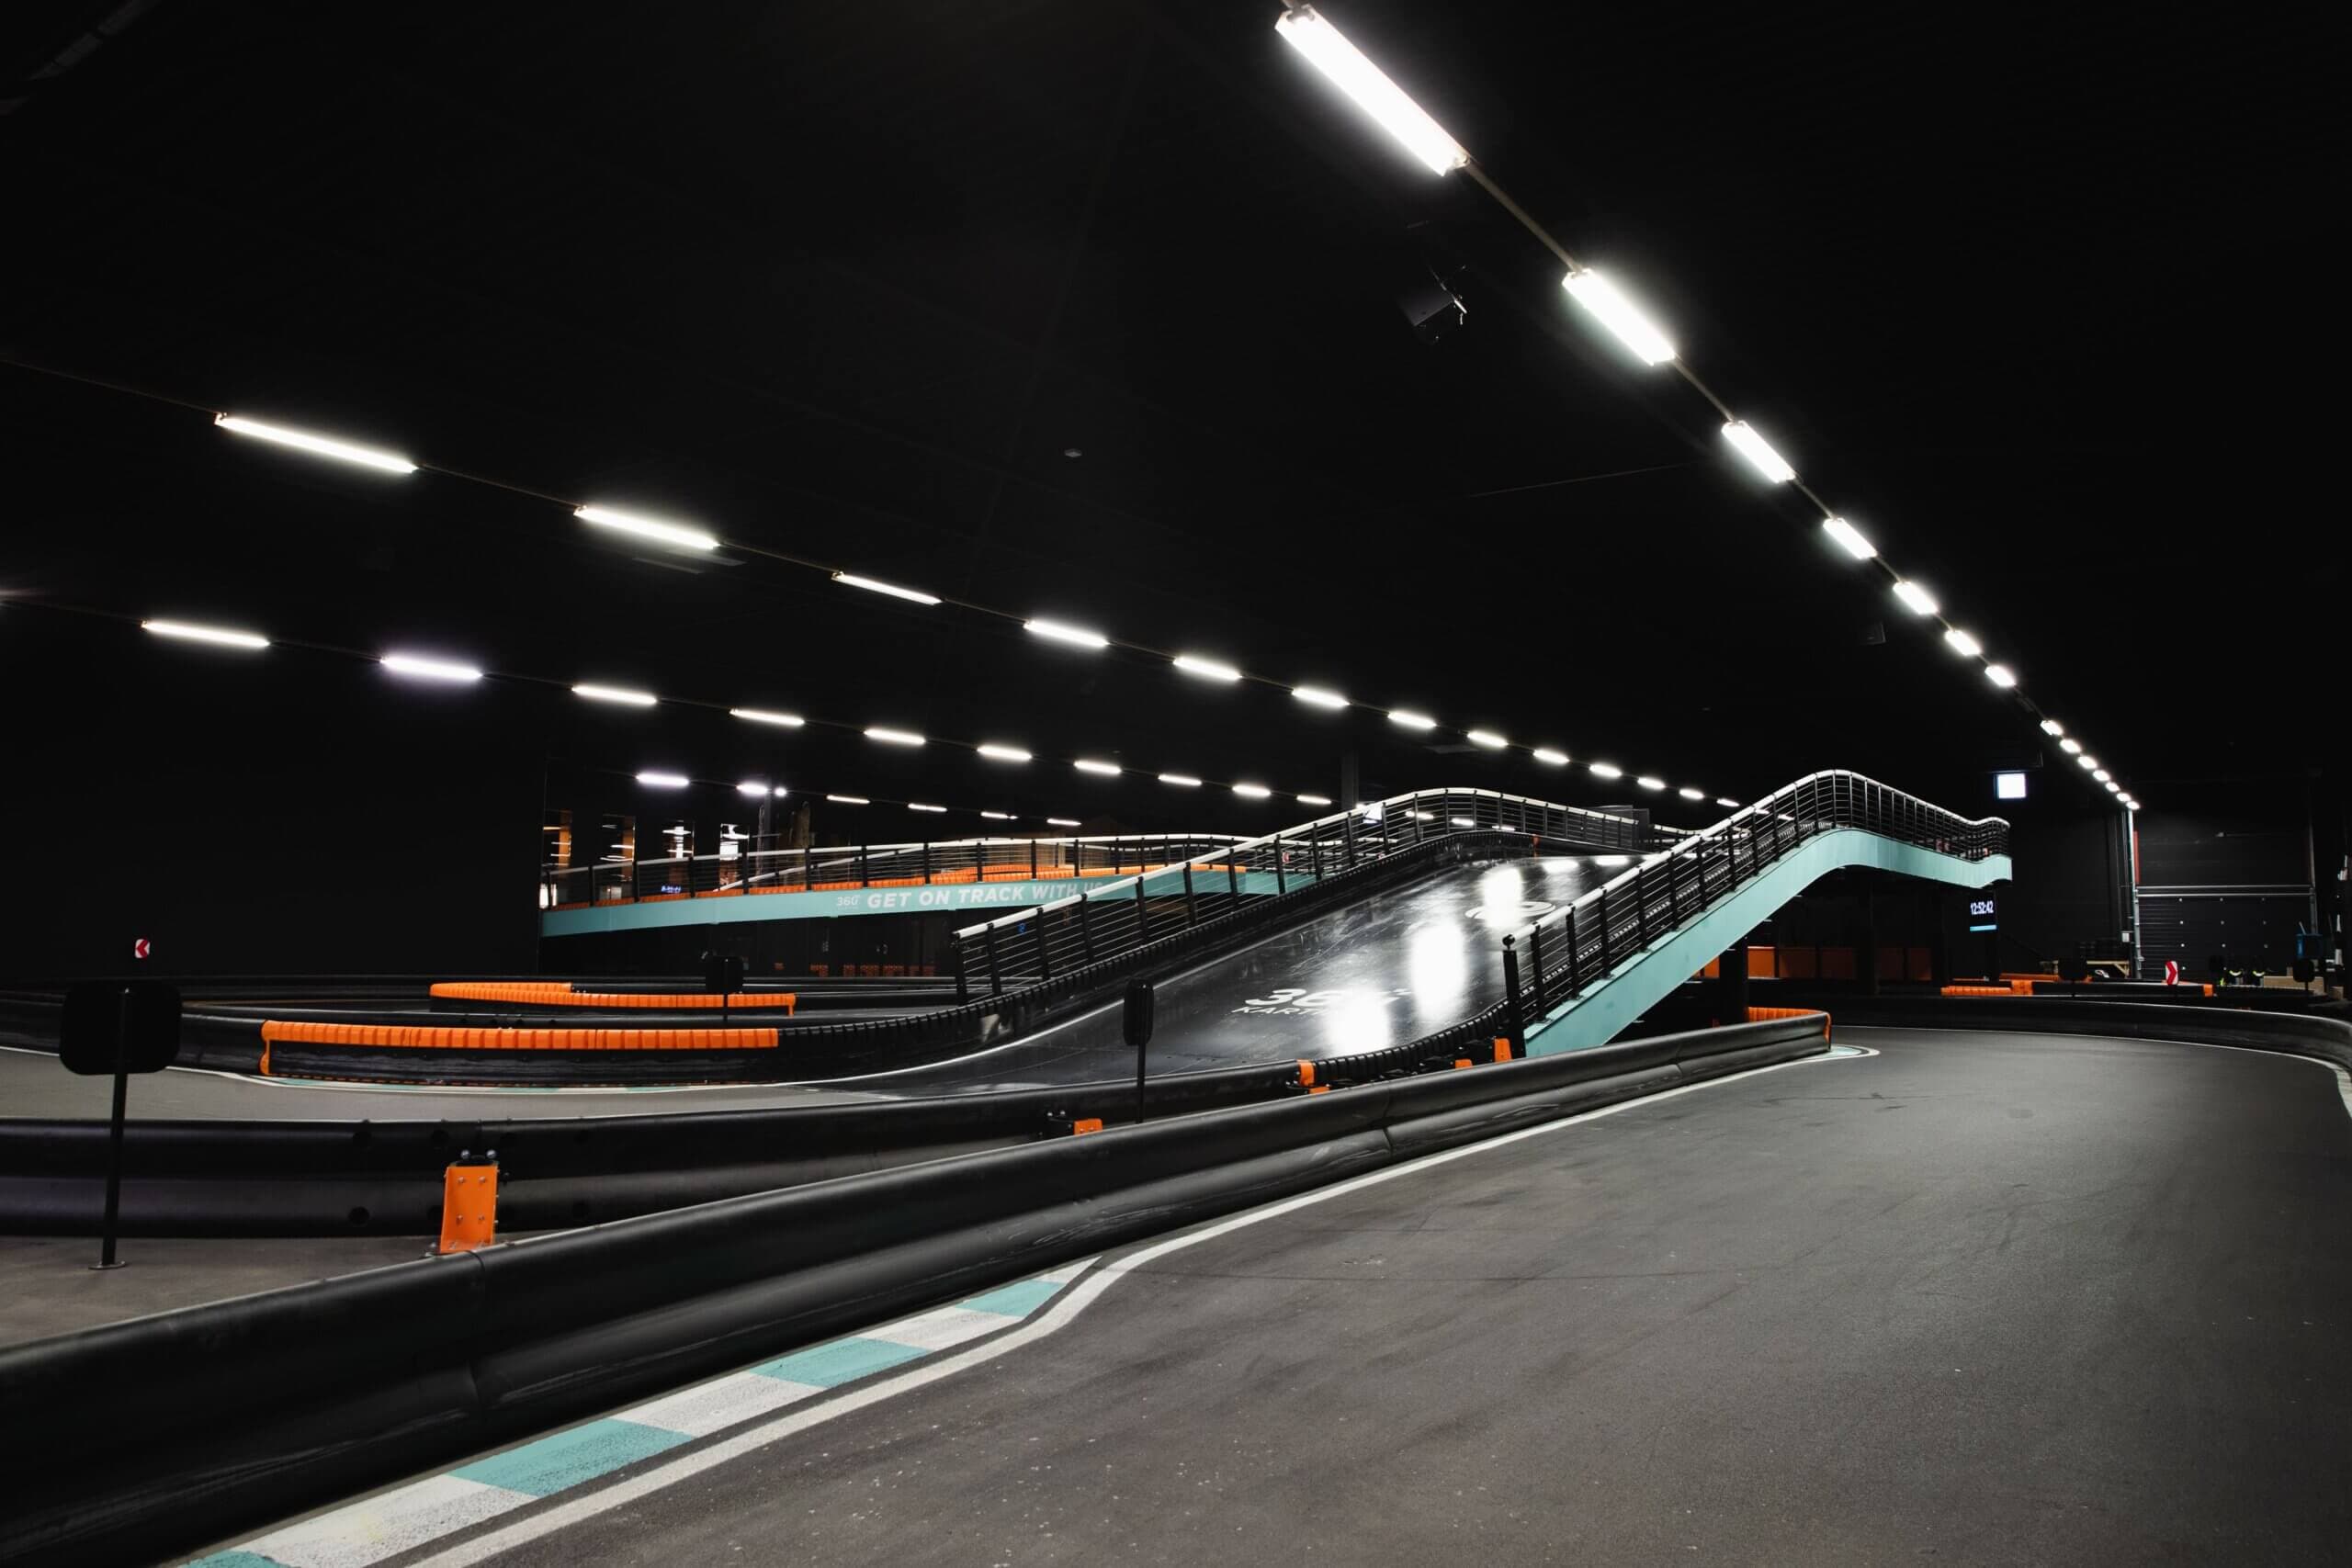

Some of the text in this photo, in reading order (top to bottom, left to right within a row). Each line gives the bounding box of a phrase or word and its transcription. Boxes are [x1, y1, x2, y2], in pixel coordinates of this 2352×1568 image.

[867, 891, 912, 908] GET
[921, 889, 950, 906] ON
[958, 886, 1025, 904] TRACK
[1032, 883, 1078, 899] WITH
